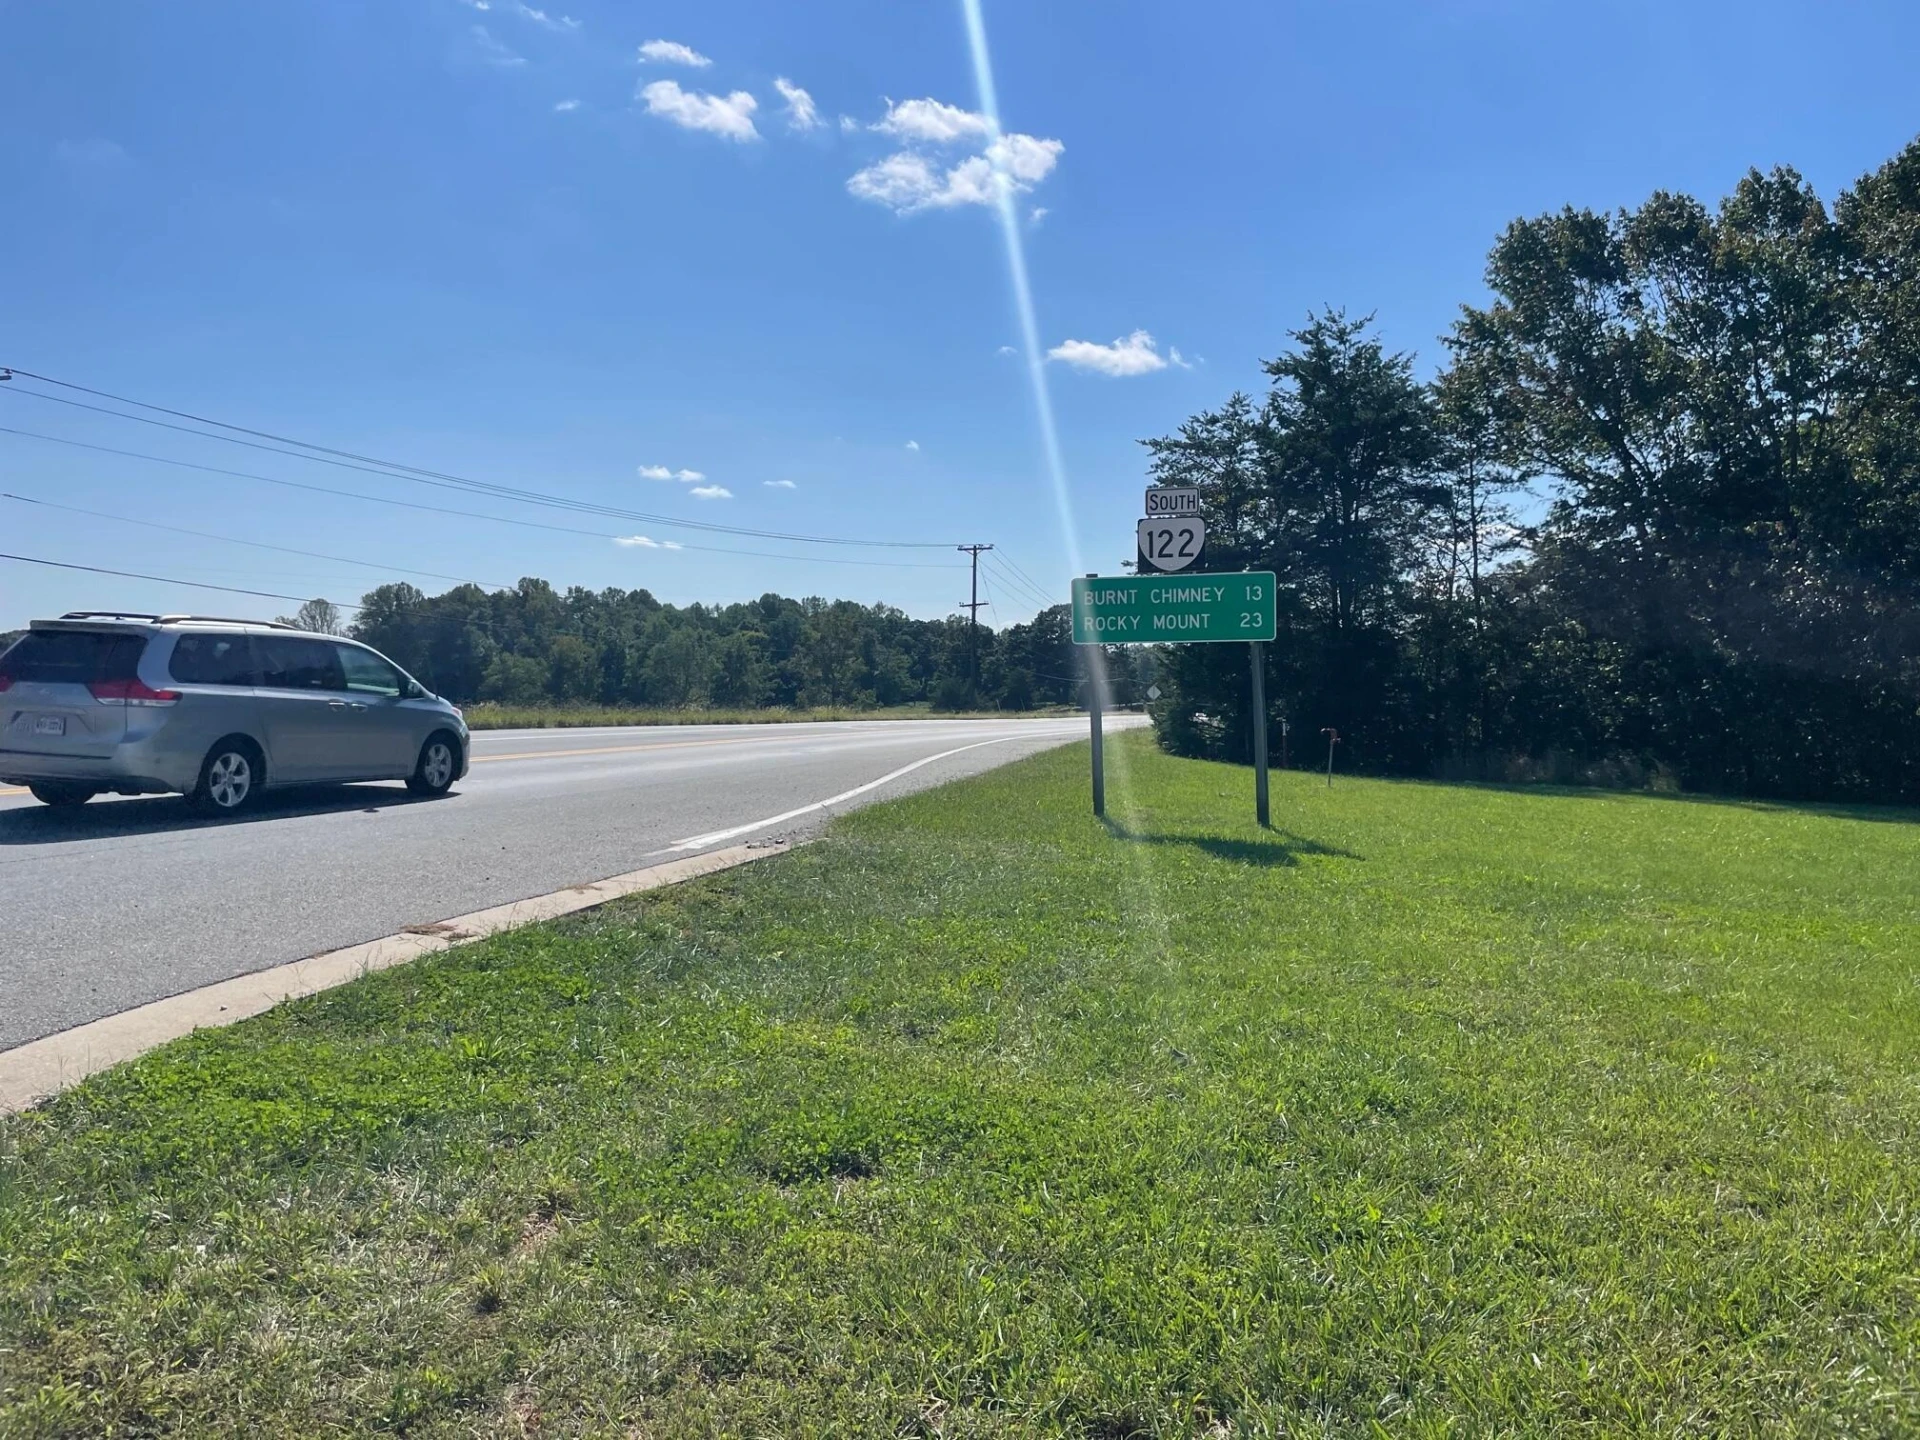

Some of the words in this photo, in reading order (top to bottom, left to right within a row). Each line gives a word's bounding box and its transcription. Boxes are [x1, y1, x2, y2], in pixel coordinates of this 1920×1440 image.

[1149, 493, 1196, 511] SOUTH
[1147, 528, 1194, 558] 122
[1084, 589, 1138, 606] BURNT
[1150, 587, 1225, 604] CHIMNEY
[1246, 586, 1262, 601] 13
[1084, 615, 1140, 631] ROCKY
[1153, 614, 1210, 630] MOUNT
[1240, 613, 1263, 628] 23
